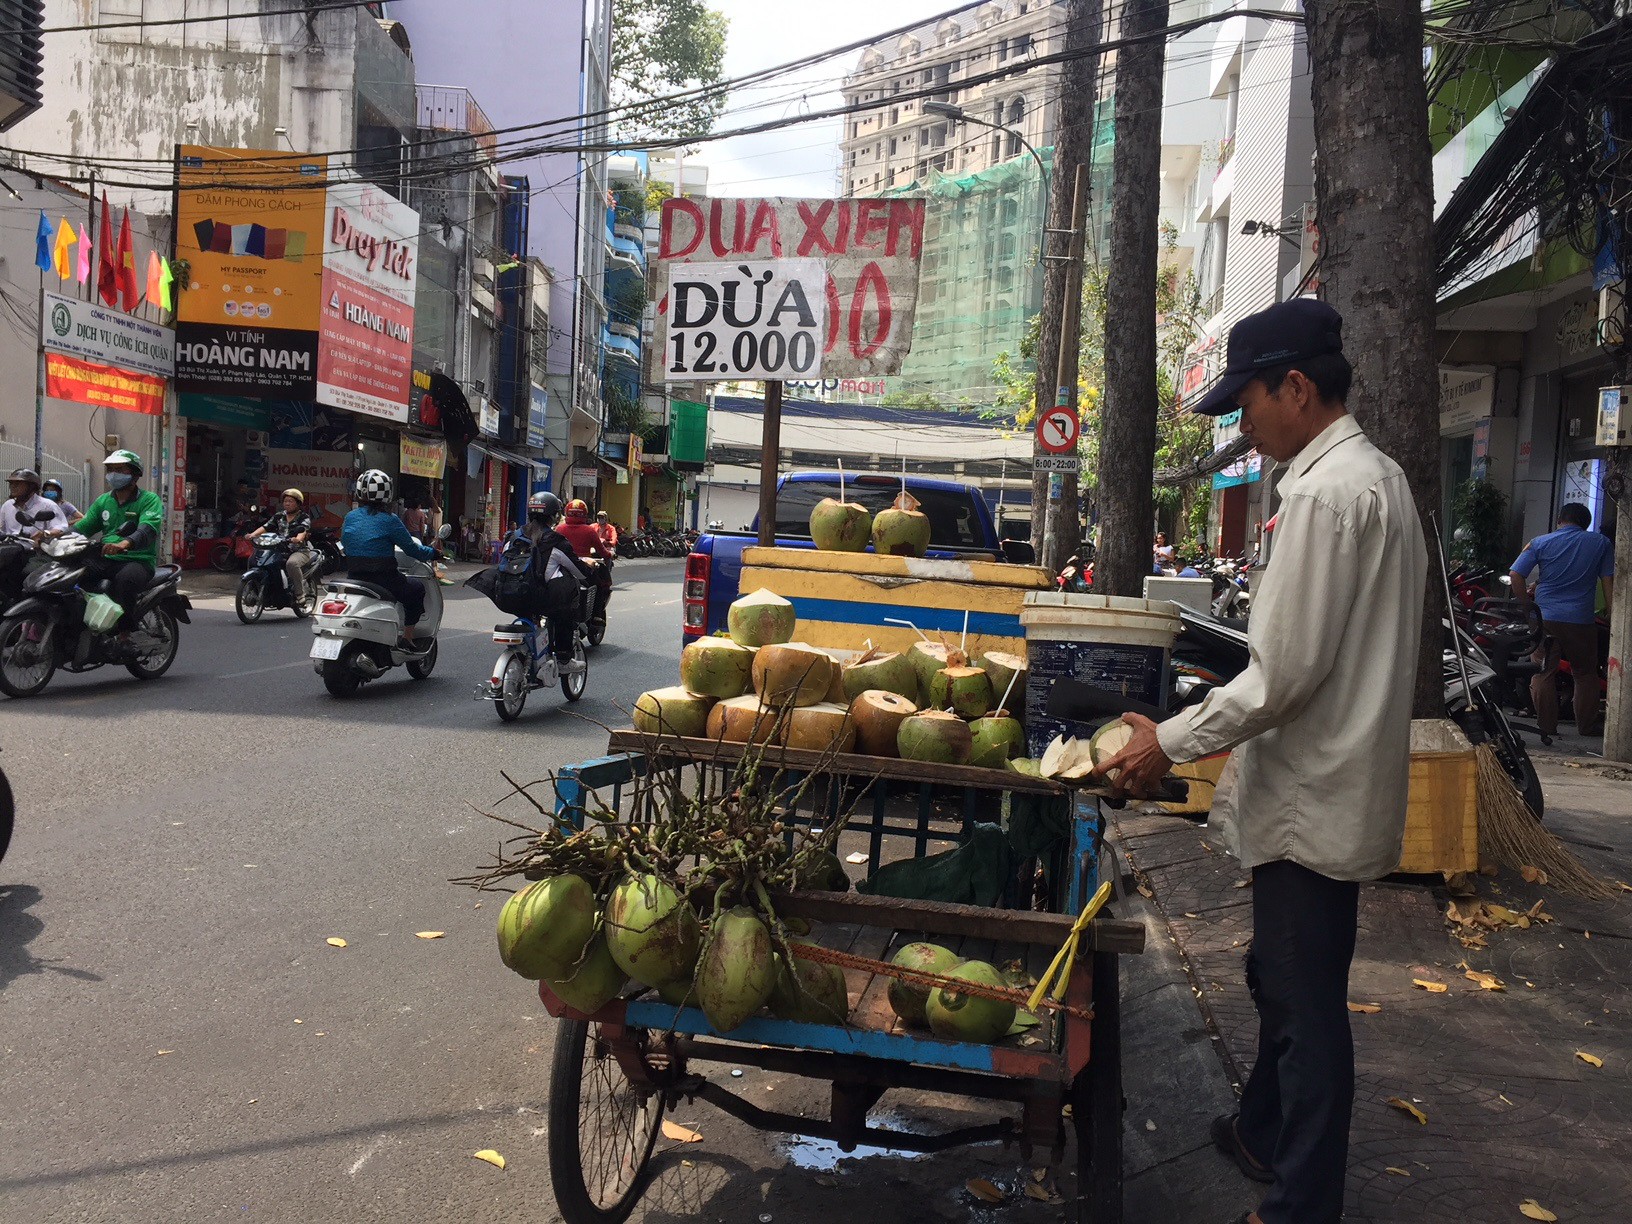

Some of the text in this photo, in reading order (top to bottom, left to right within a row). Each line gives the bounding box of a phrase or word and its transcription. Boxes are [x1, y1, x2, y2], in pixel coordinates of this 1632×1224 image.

[224, 196, 266, 208] PHONG
[232, 267, 267, 275] PASSPORT
[671, 264, 817, 328] DỪA
[90, 309, 106, 320] CÔNG
[106, 314, 112, 322] TY
[345, 301, 384, 334] HOÀNG
[386, 320, 410, 344] NAM
[77, 323, 97, 342] DỊCH
[100, 329, 111, 348] VỤ
[113, 332, 133, 350] CÔNG
[135, 338, 148, 355] ÍCH
[150, 344, 169, 362] QUẬN
[226, 330, 265, 343] VI TÍNH
[176, 338, 310, 371] HOÀNG NAM
[670, 330, 816, 373] 12.000
[272, 463, 350, 478] HOÀNG NAM
